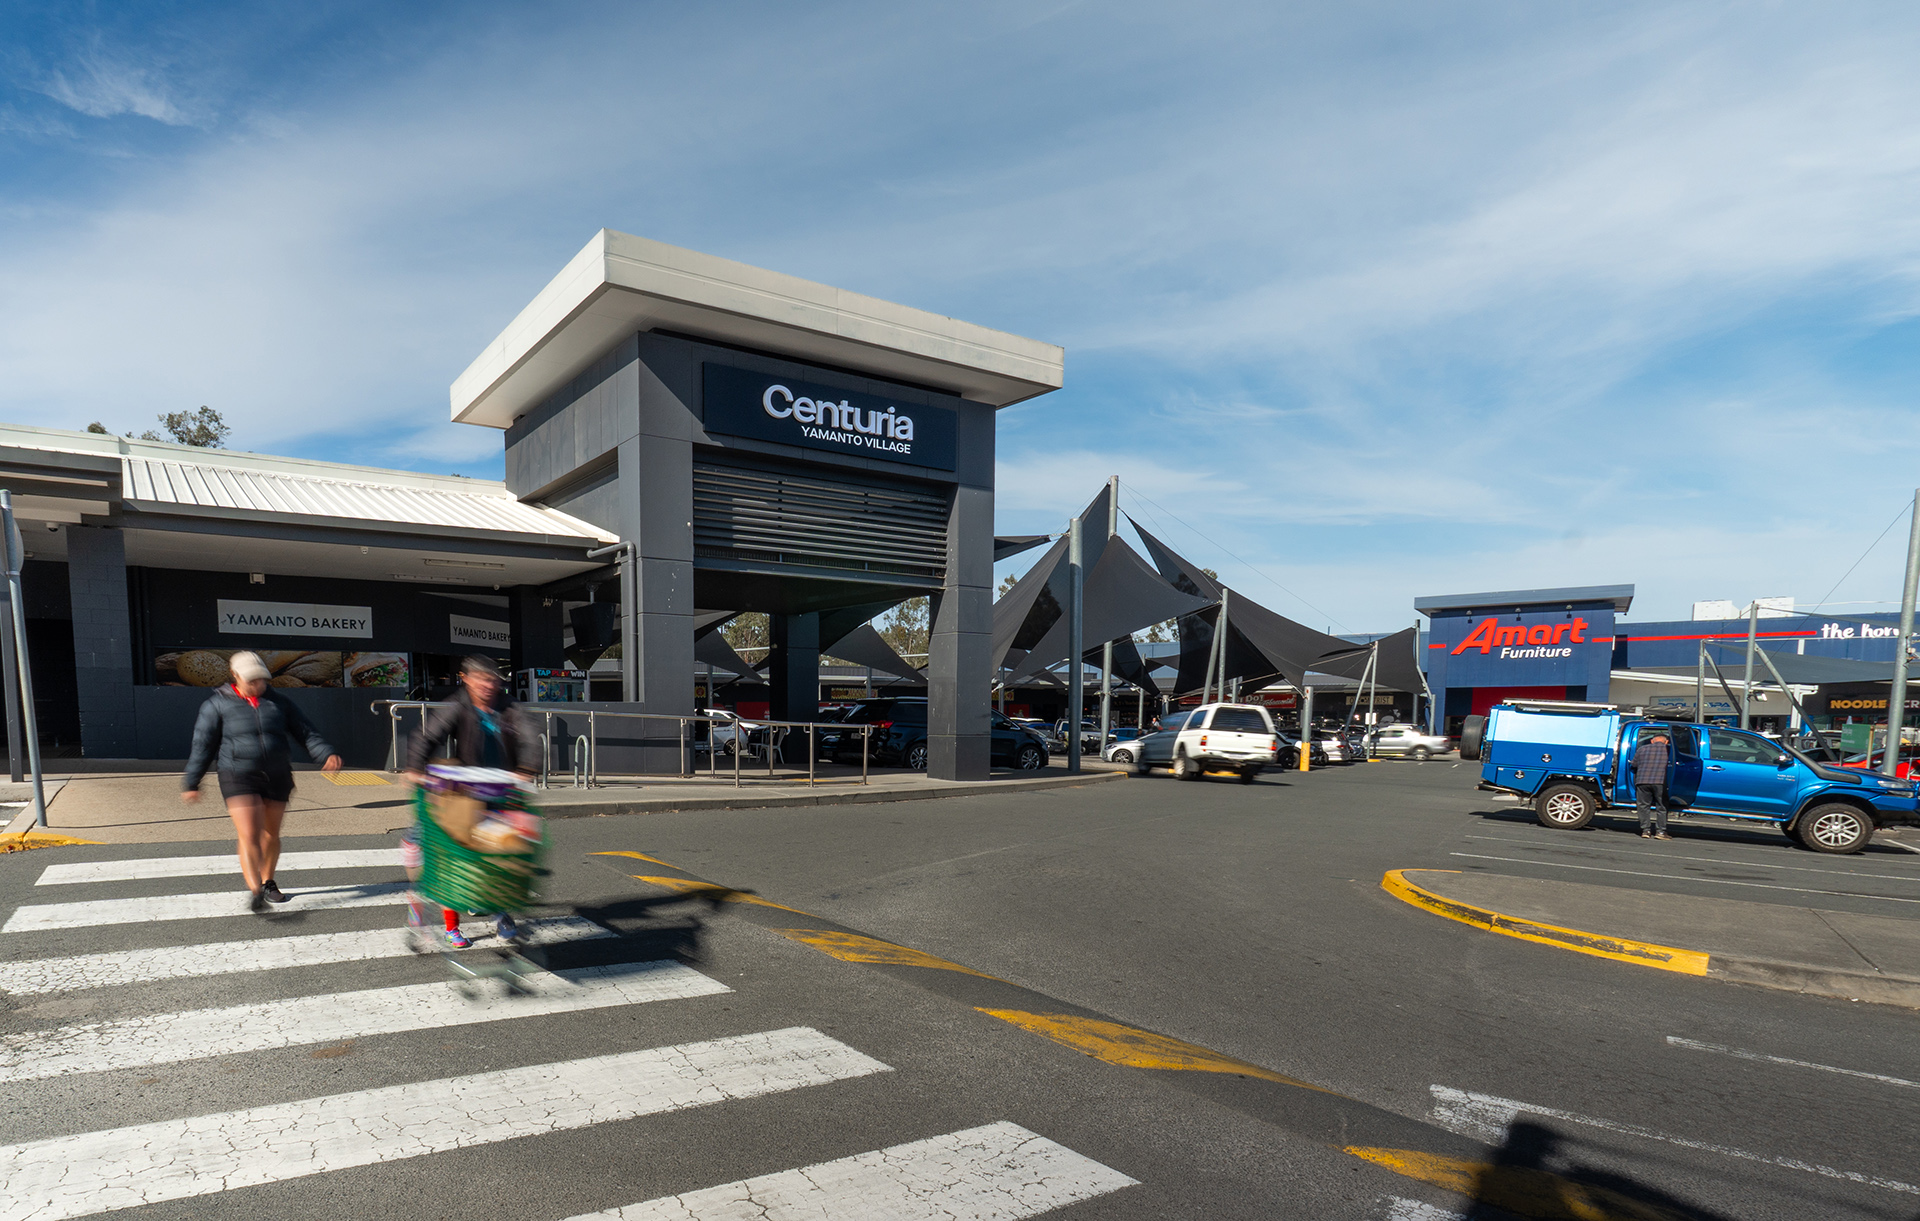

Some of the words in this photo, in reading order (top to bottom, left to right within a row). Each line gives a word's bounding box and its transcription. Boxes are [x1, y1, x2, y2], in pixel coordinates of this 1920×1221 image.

[762, 384, 914, 441] Centuria
[801, 425, 863, 446] YAMANTO
[864, 436, 912, 455] VILLAGE
[226, 613, 307, 628] YAMANTO
[312, 617, 366, 630] BAKERY
[453, 626, 487, 640] YAMANTO
[1450, 617, 1589, 655] Amart
[1821, 622, 1855, 640] the
[1500, 646, 1572, 660] Furniture
[536, 669, 551, 677] TAP
[570, 670, 585, 678] WIN
[1830, 699, 1887, 709] NOODLE
